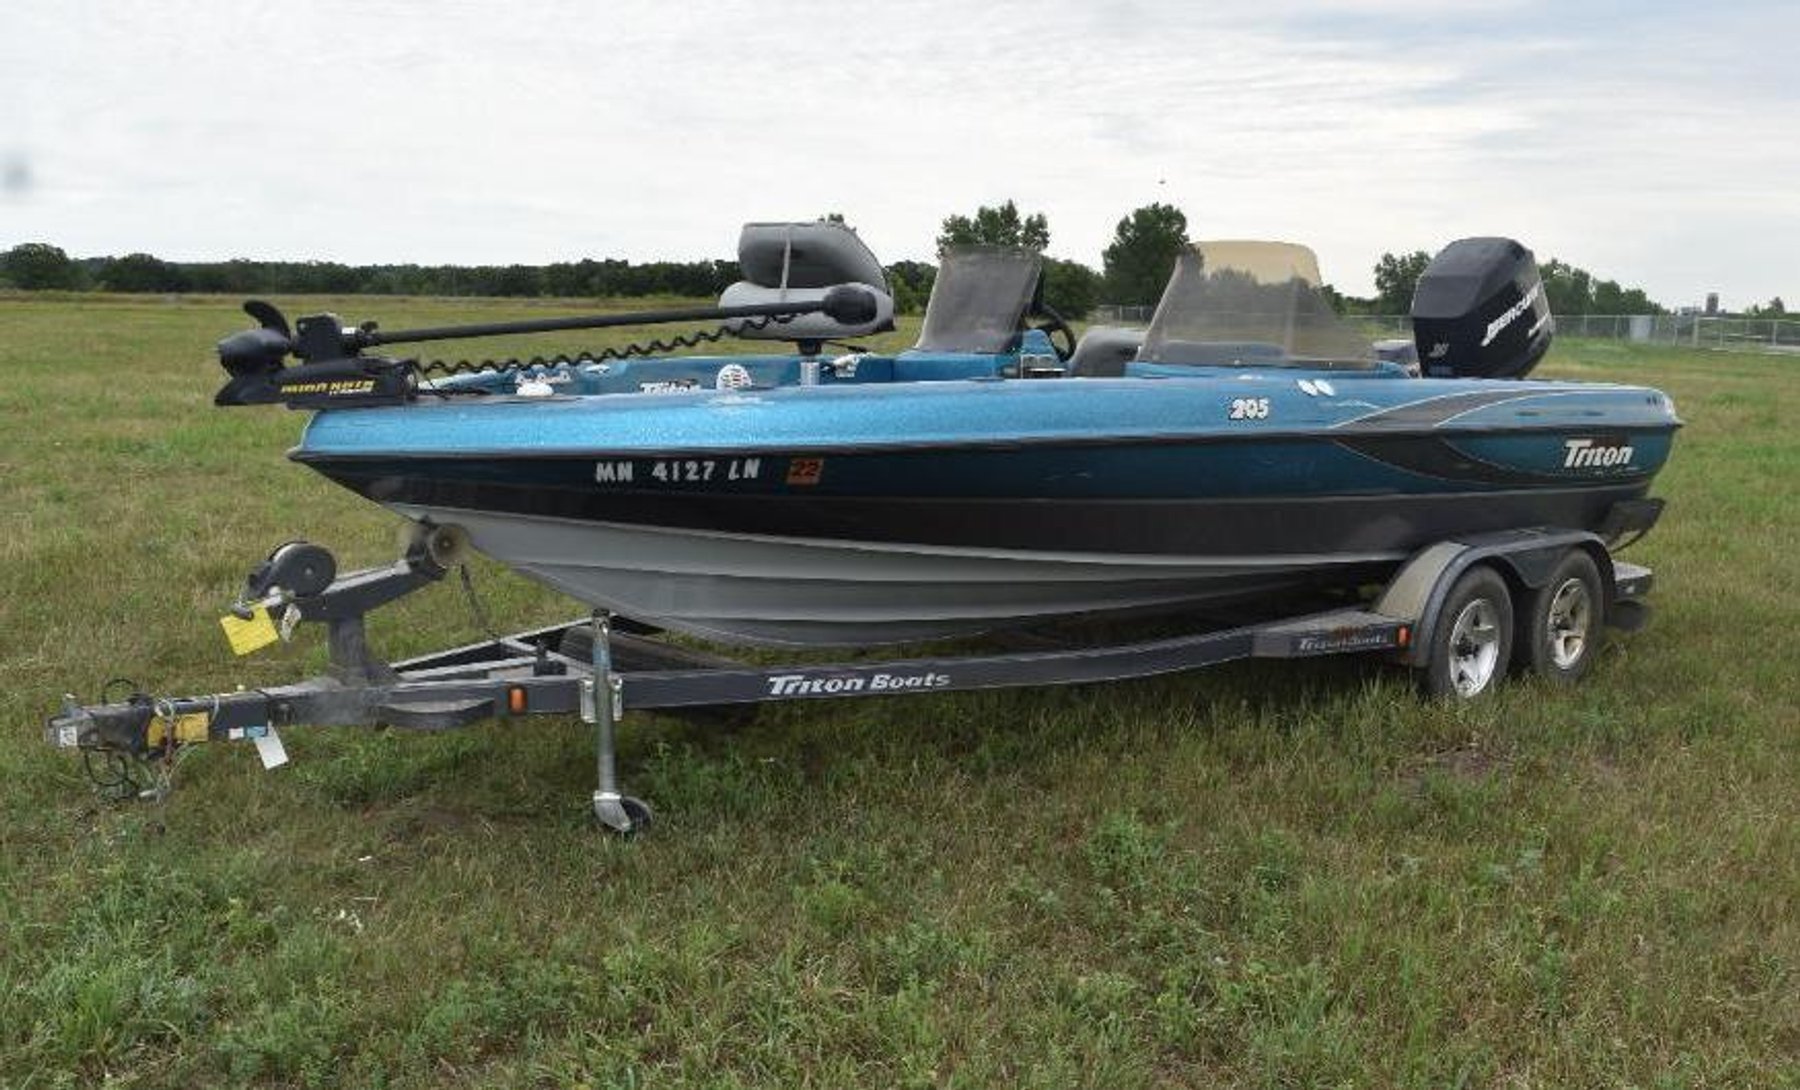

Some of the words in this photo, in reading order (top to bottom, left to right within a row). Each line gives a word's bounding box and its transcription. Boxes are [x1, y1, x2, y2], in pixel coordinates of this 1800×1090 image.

[1229, 398, 1269, 420] 205
[1564, 439, 1634, 468] Triton
[596, 461, 633, 482] MN
[652, 460, 715, 482] 4127
[728, 458, 761, 480] LN
[768, 674, 865, 696] Triton
[869, 672, 951, 690] Boats
